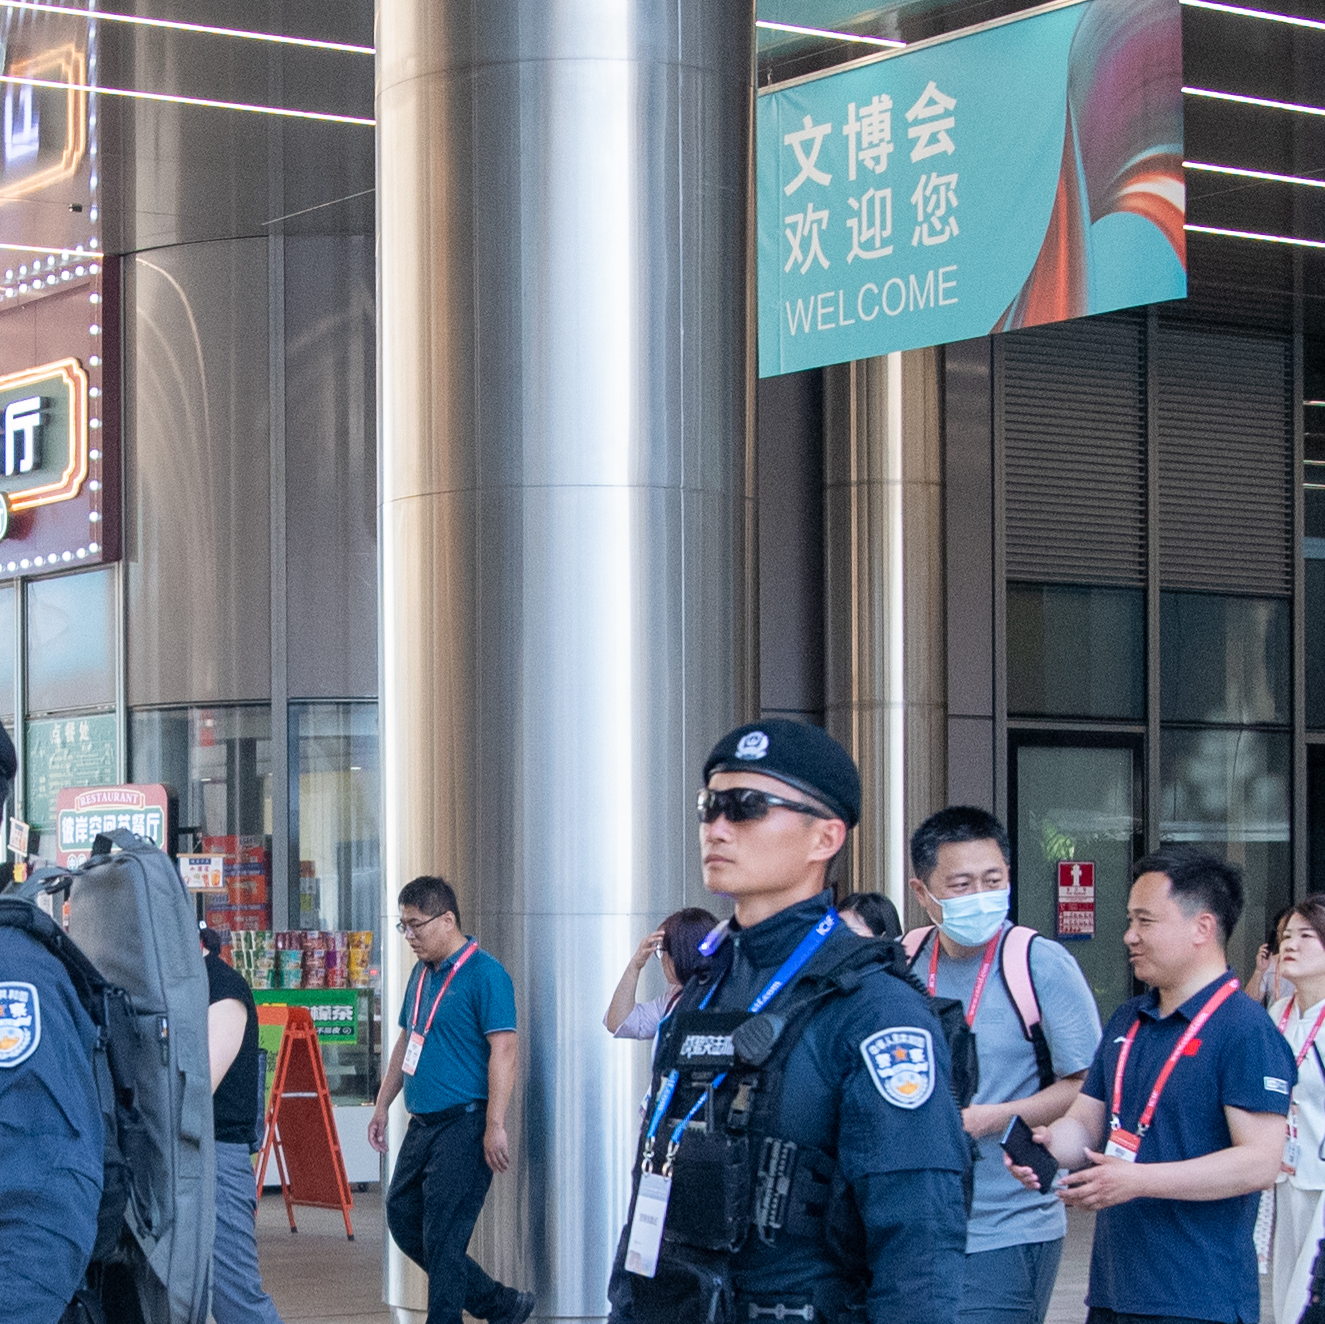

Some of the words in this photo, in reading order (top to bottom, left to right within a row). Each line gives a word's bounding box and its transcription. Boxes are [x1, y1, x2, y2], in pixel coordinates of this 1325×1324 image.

[783, 80, 958, 197] 文博会
[784, 171, 959, 276] 欢迎您
[785, 264, 959, 336] WELCOME
[79, 792, 138, 807] RESTAURANT
